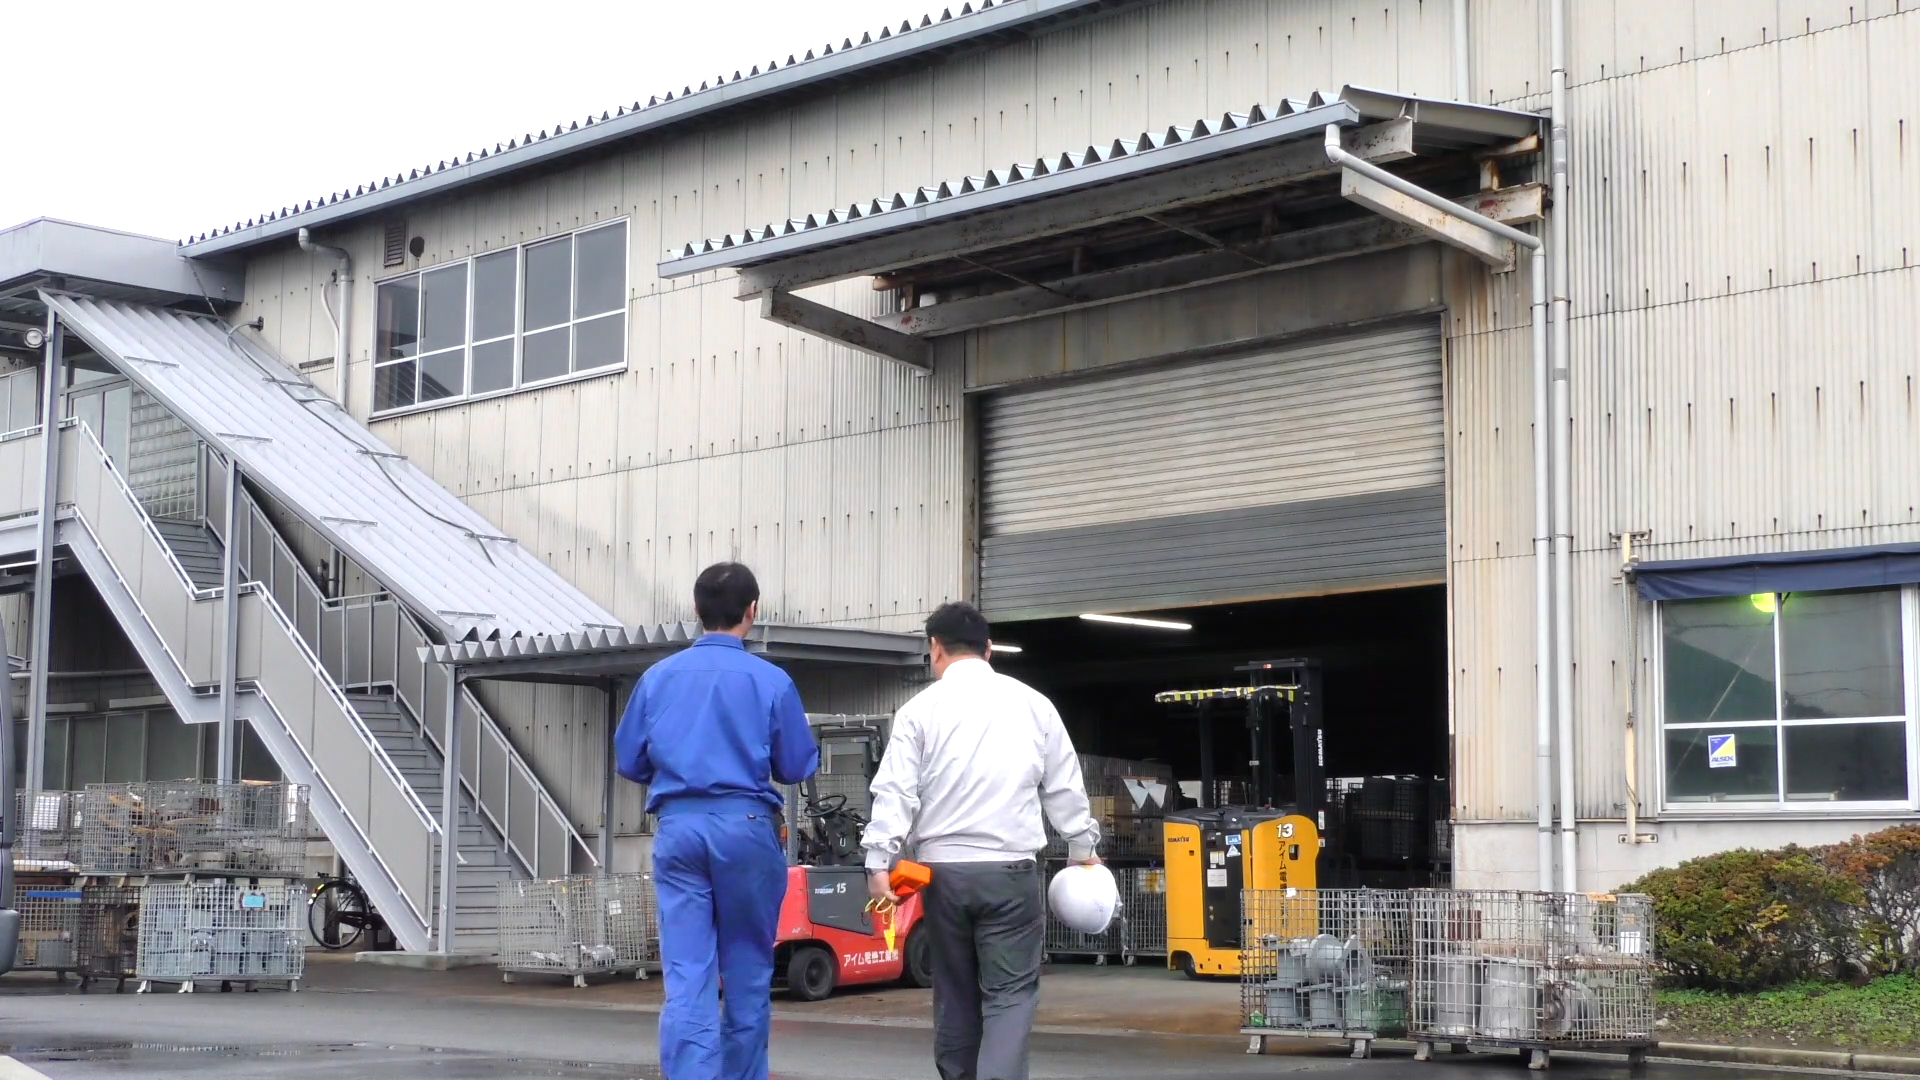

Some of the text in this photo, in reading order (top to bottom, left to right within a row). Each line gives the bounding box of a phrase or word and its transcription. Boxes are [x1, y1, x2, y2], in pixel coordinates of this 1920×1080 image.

[1316, 728, 1324, 767] KOMATSU
[1276, 823, 1293, 838] 13
[836, 882, 847, 894] 15
